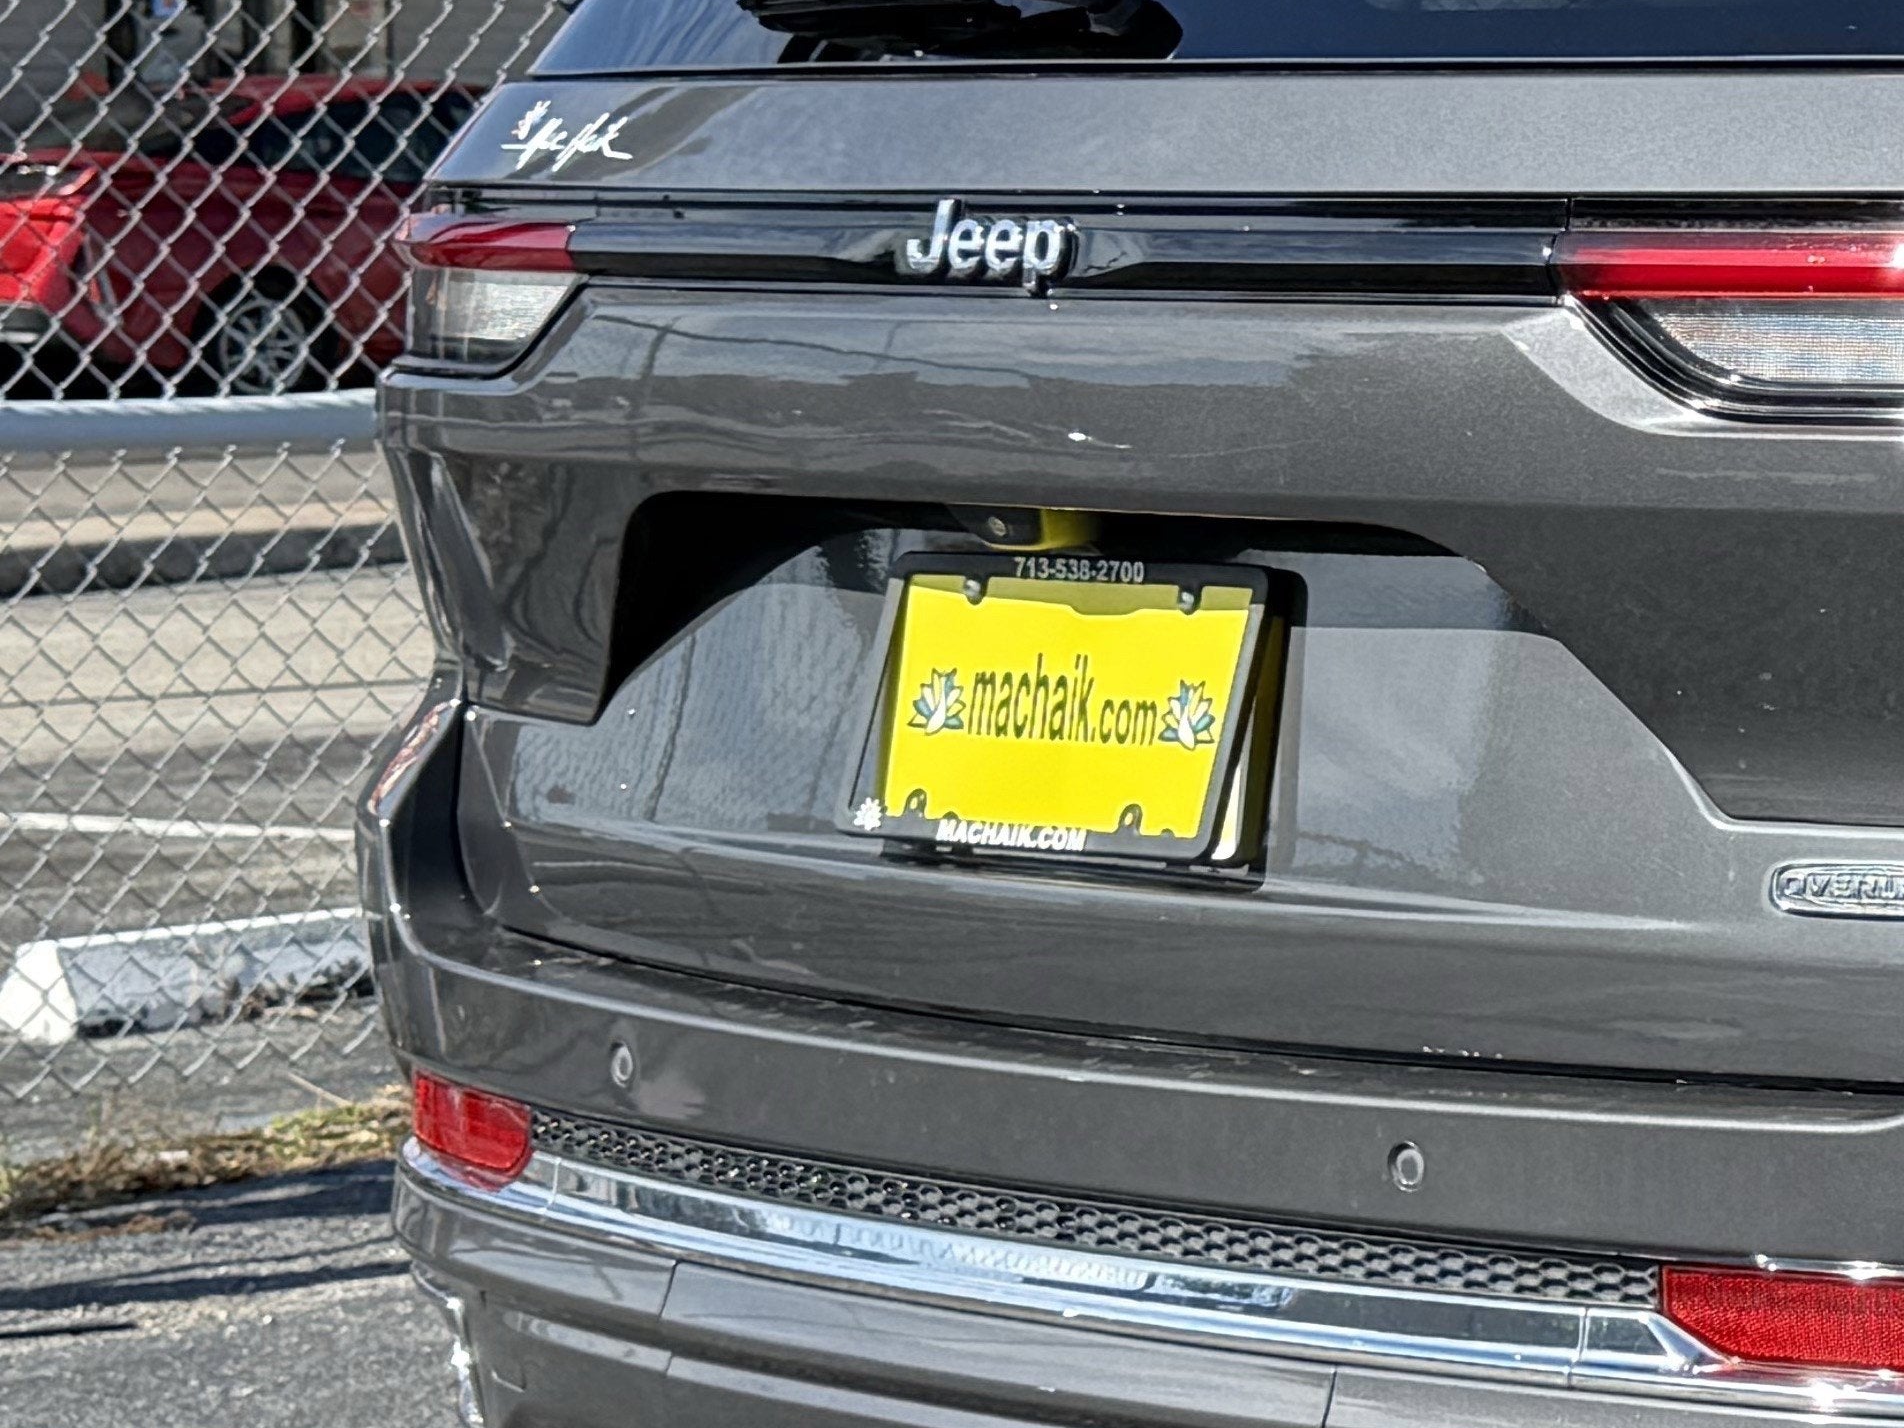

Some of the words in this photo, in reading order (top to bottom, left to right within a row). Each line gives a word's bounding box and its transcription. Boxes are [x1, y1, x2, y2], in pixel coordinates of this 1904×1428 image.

[905, 198, 1075, 298] Jeep
[966, 652, 1158, 747] machaik.com
[936, 818, 1087, 852] MACHAIK.COM
